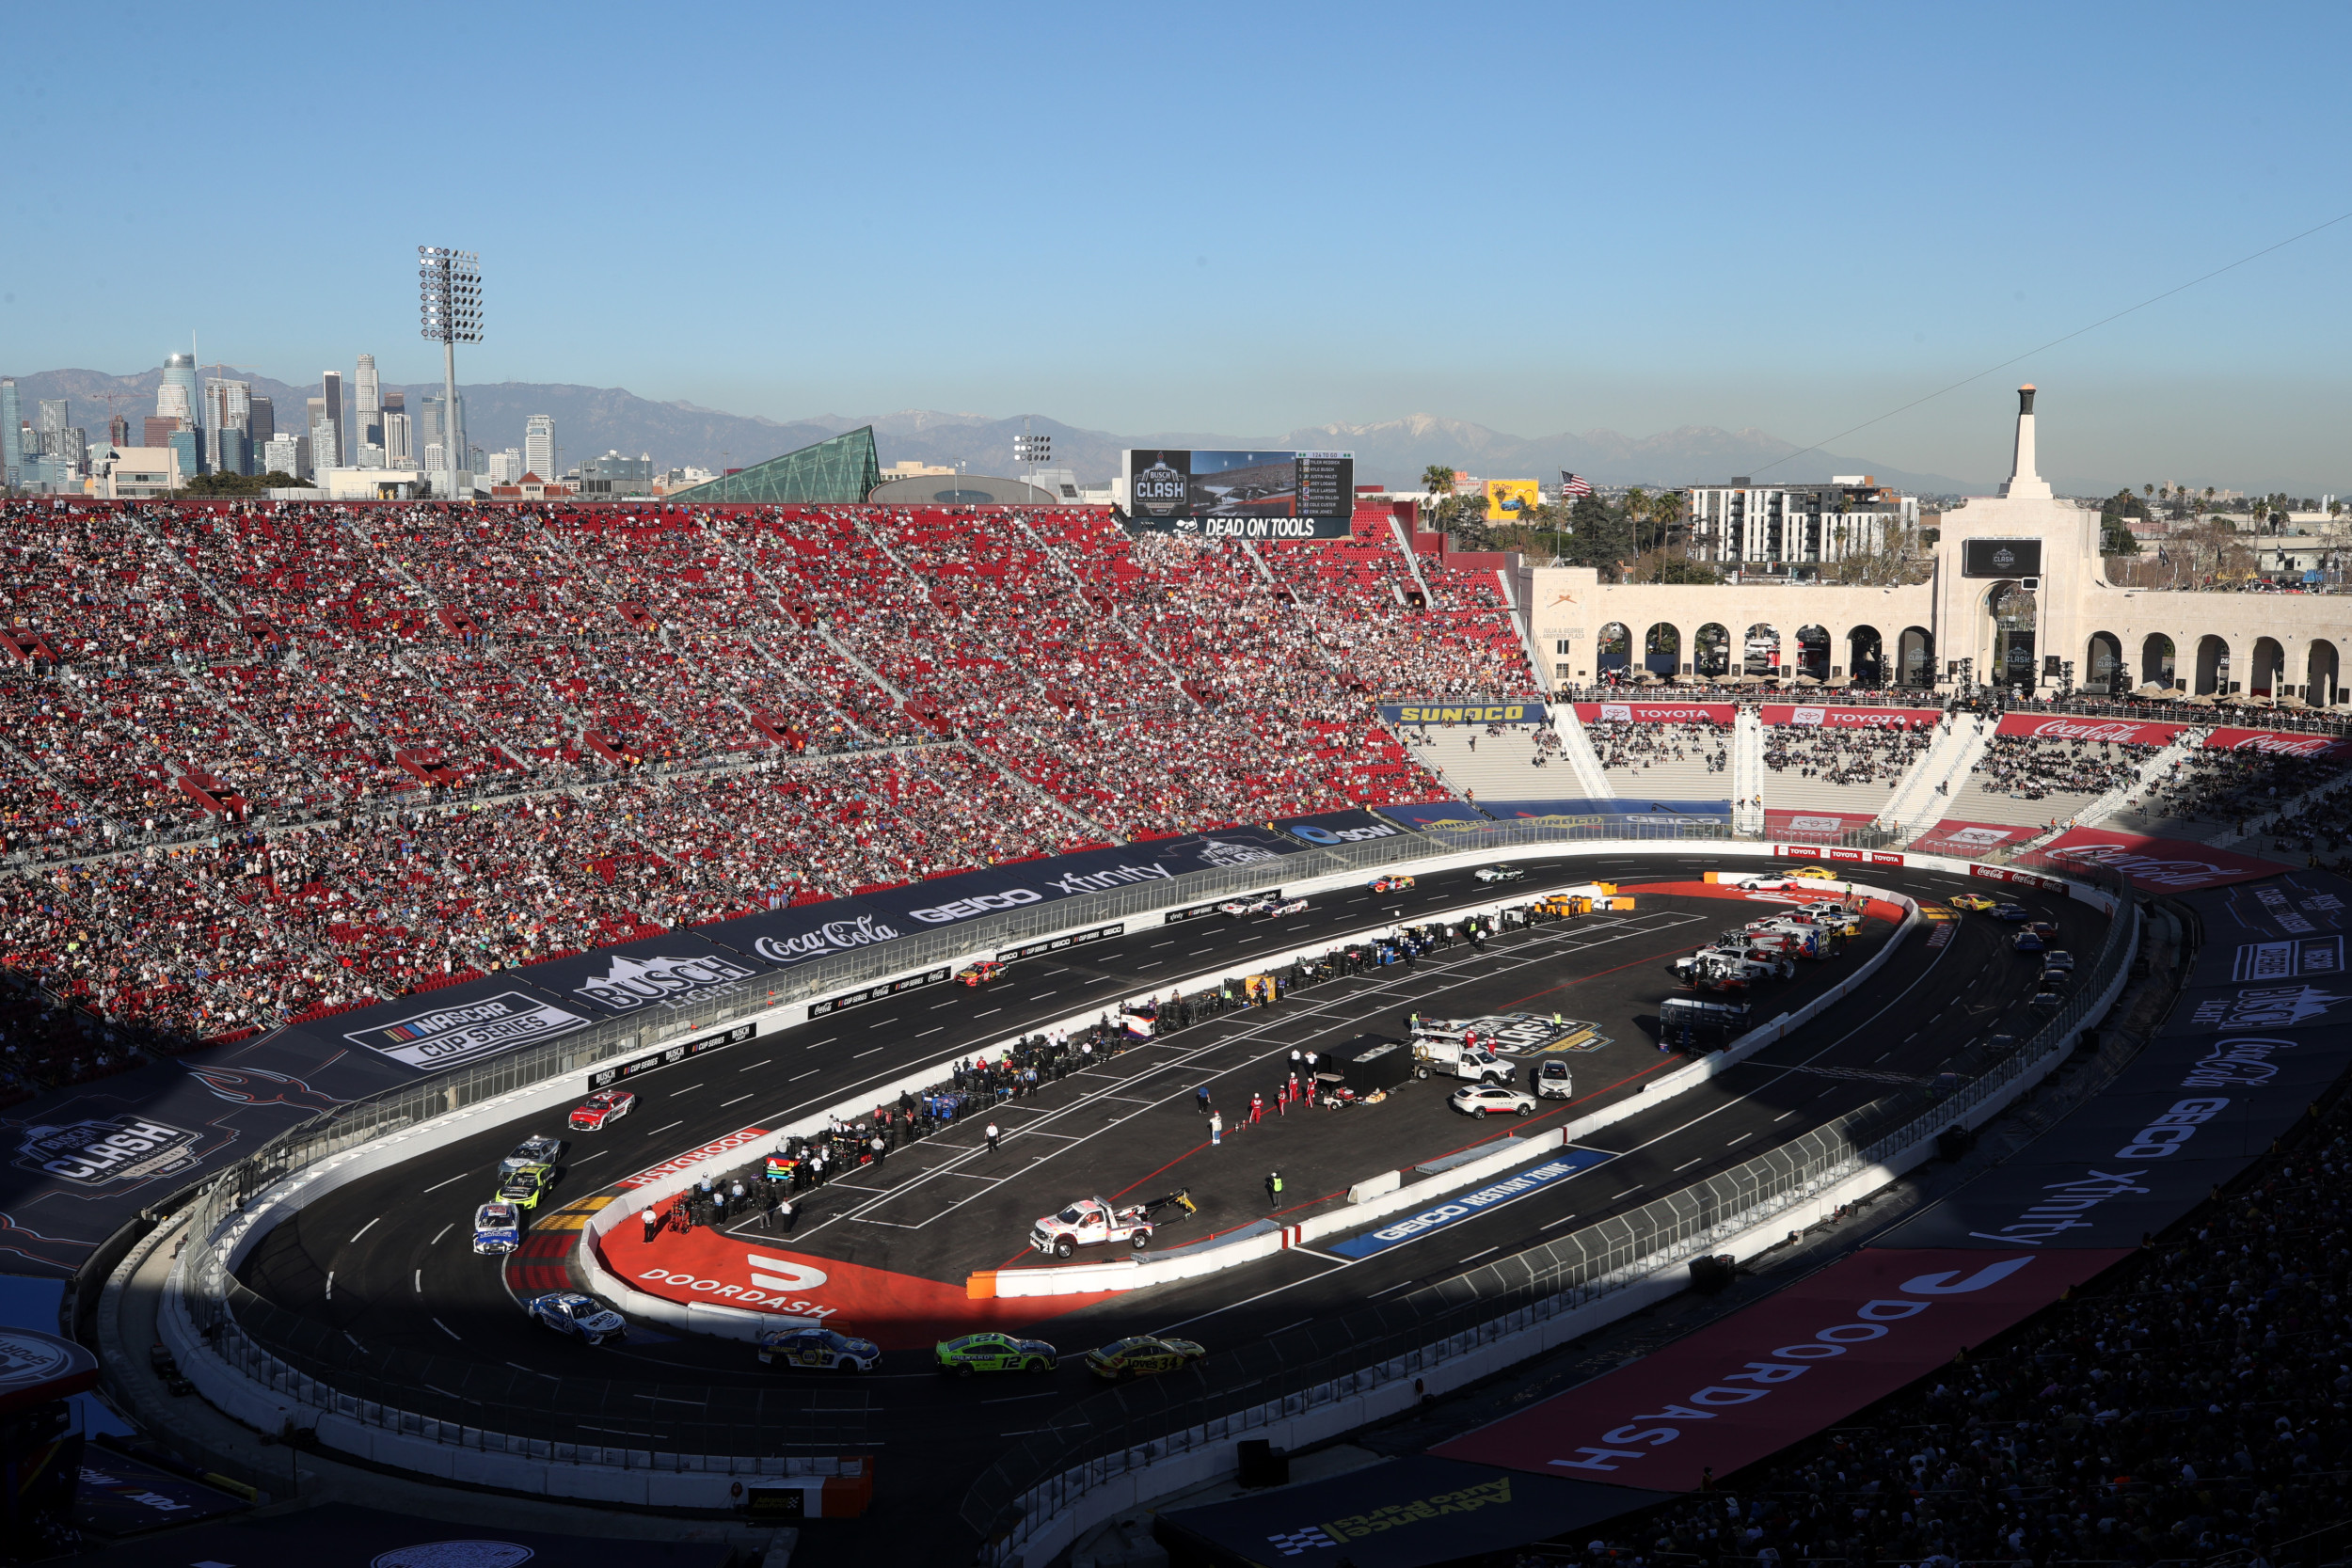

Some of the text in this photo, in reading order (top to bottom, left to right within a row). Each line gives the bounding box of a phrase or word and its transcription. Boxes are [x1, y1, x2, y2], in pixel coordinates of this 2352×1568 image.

[1136, 482, 1184, 498] CLASH
[1206, 517, 1314, 537] DEAD ON TOOLS
[2005, 655, 2030, 663] CLASH
[1400, 705, 1524, 721] SUNOCO
[1636, 709, 1710, 719] TOYOTA
[1831, 713, 1907, 723] TOYOTA
[2033, 720, 2146, 741] Coca-Cola
[1422, 819, 1488, 832] SUNOCO
[1519, 816, 1603, 826] SUNOCO
[1627, 815, 1722, 826] GEICO
[1336, 824, 1397, 842] SCW
[1214, 850, 1282, 867] CLASH
[1833, 850, 1858, 859] TOYOTA
[1874, 854, 1899, 863] TOYOTA
[1046, 863, 1176, 895] xfinity
[1977, 866, 2005, 879] Coca-Cola
[2011, 873, 2036, 886] Coca-Cola
[2042, 879, 2063, 894] Coca-Cola
[908, 888, 1042, 923] GEICO
[1169, 911, 1184, 921] xfinity
[755, 914, 899, 961] Coca-Cola
[998, 951, 1018, 962] GEICO
[1051, 938, 1071, 949] GEICO
[1103, 927, 1121, 937] GEICO
[574, 956, 755, 1008] BUSCH
[815, 970, 946, 1016] Coca-Cola CUP SERIES Coca-Cola CUP SERIES Coca-Cola
[421, 1002, 513, 1034] NASCAR
[418, 1015, 548, 1057] CUP SERIES
[596, 1025, 750, 1083] BUSCH CUP SERIES BUSCH CUP SERIES BUSCH
[2114, 1097, 2231, 1158] GEICO
[39, 1128, 94, 1150] BUSCH
[42, 1122, 180, 1178] CLASH
[104, 1141, 176, 1176] AT THE COLISEUM
[627, 1132, 760, 1185] DOORDASH
[129, 1149, 182, 1175] LOS ANGELES
[1372, 1162, 1577, 1242] GEICO RESTART ZONE
[1968, 1169, 2151, 1245] xfinity
[637, 1268, 839, 1319] DOORDASH
[563, 1318, 573, 1332] 20
[821, 1354, 834, 1365] 9
[1001, 1356, 1022, 1369] 12
[1158, 1356, 1178, 1370] 34
[1546, 1299, 1933, 1471] DOORDASH
[124, 1491, 192, 1512] FOX
[1337, 1500, 1425, 1528] Parts
[1344, 1488, 1512, 1538] Advance
